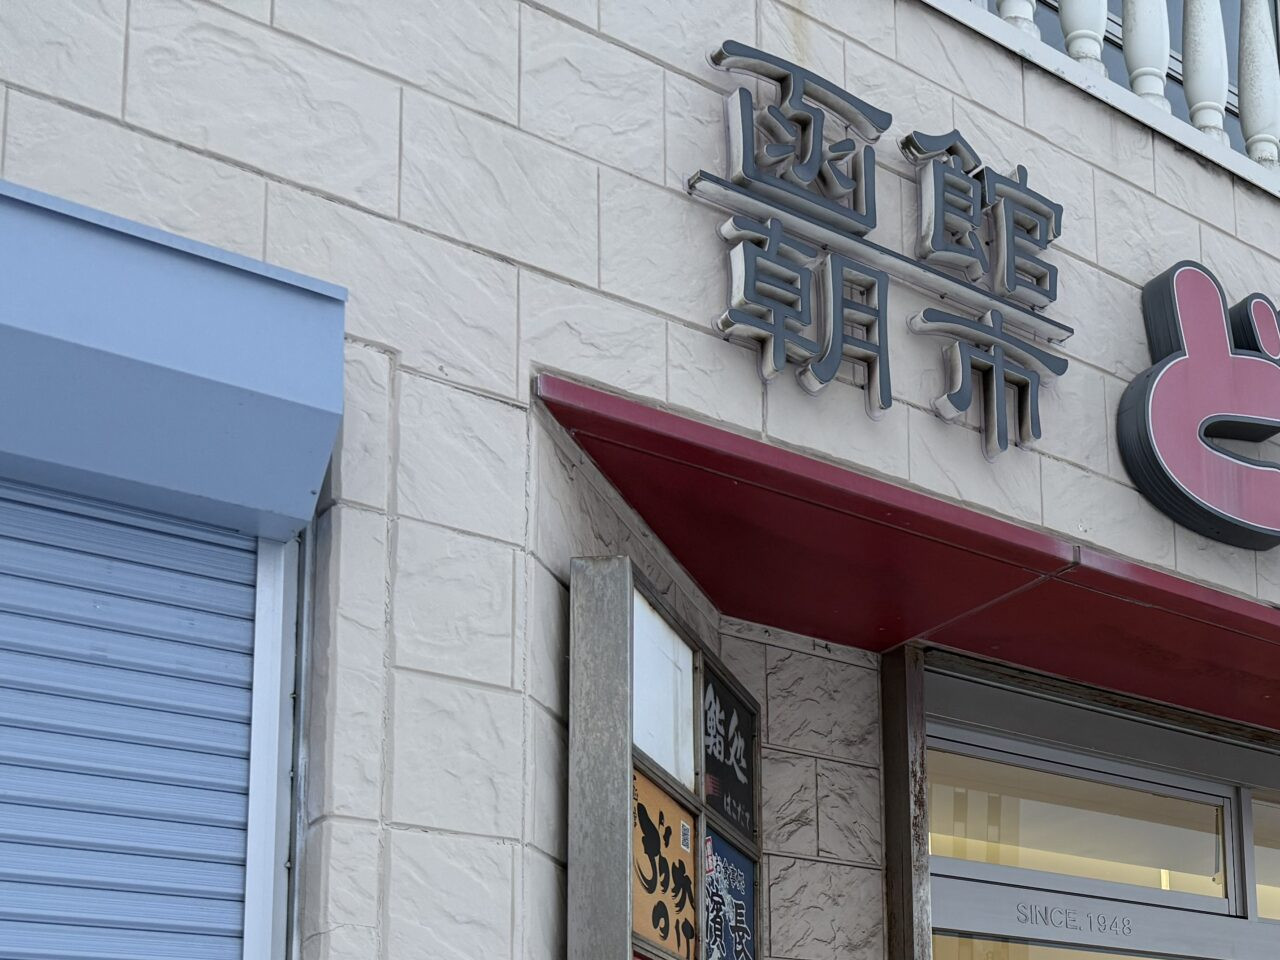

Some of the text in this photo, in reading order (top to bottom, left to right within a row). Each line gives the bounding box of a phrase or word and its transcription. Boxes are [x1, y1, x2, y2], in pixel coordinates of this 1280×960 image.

[706, 40, 1064, 306] 函館
[714, 217, 1069, 455] 朝市
[705, 683, 748, 784] 鮨処
